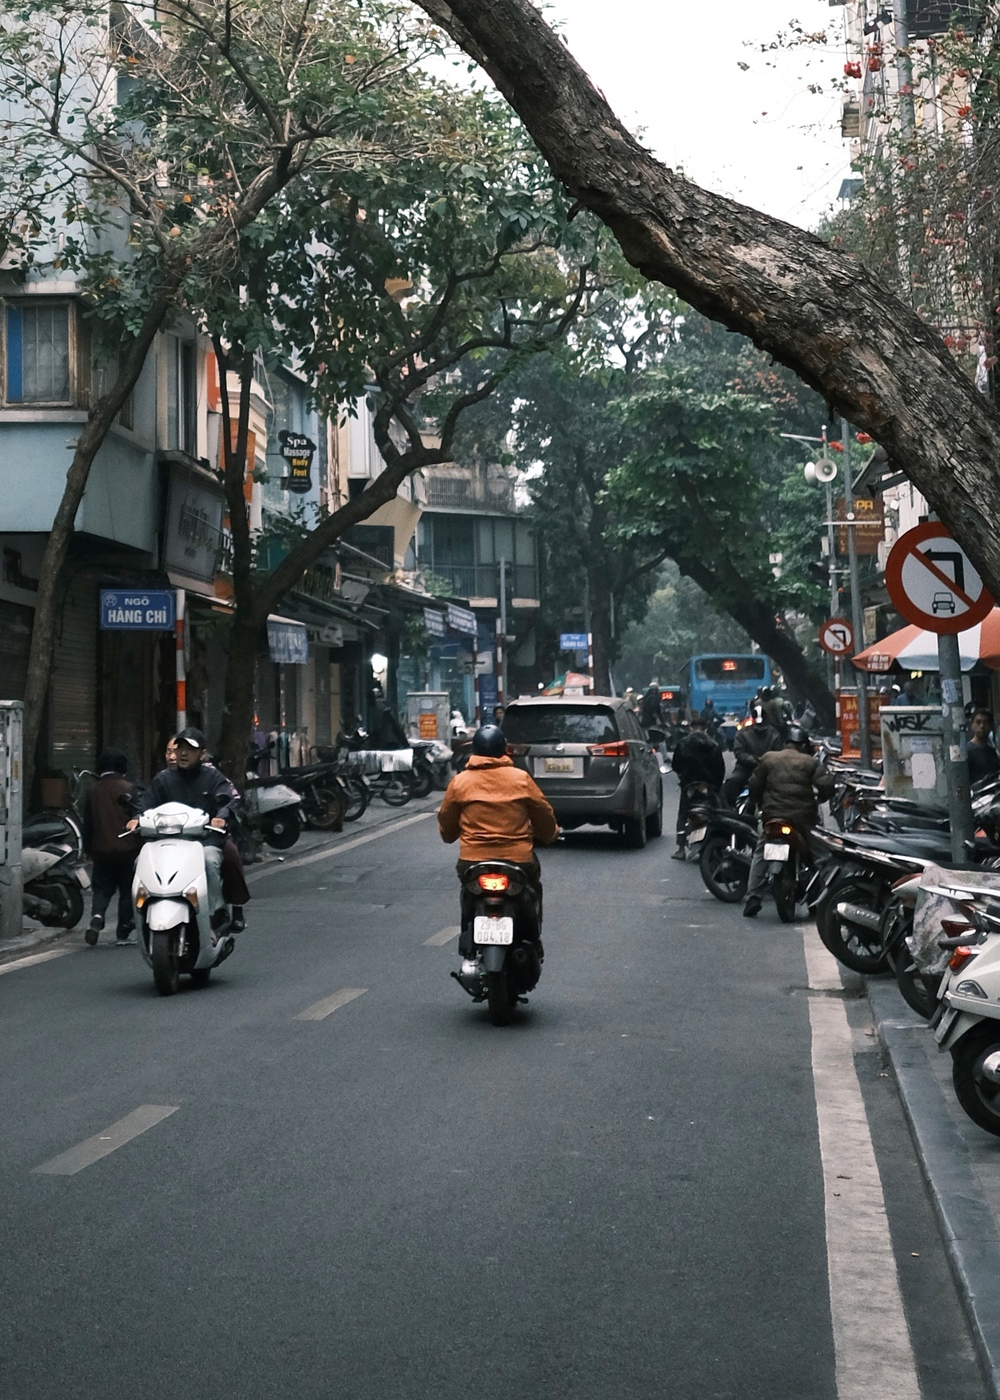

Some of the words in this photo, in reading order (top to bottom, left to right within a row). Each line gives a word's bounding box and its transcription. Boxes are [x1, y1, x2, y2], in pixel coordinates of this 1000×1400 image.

[287, 436, 307, 448] Spa
[124, 595, 150, 606] NGÕ
[107, 606, 143, 623] HÀNG
[145, 605, 167, 624] CHỈ
